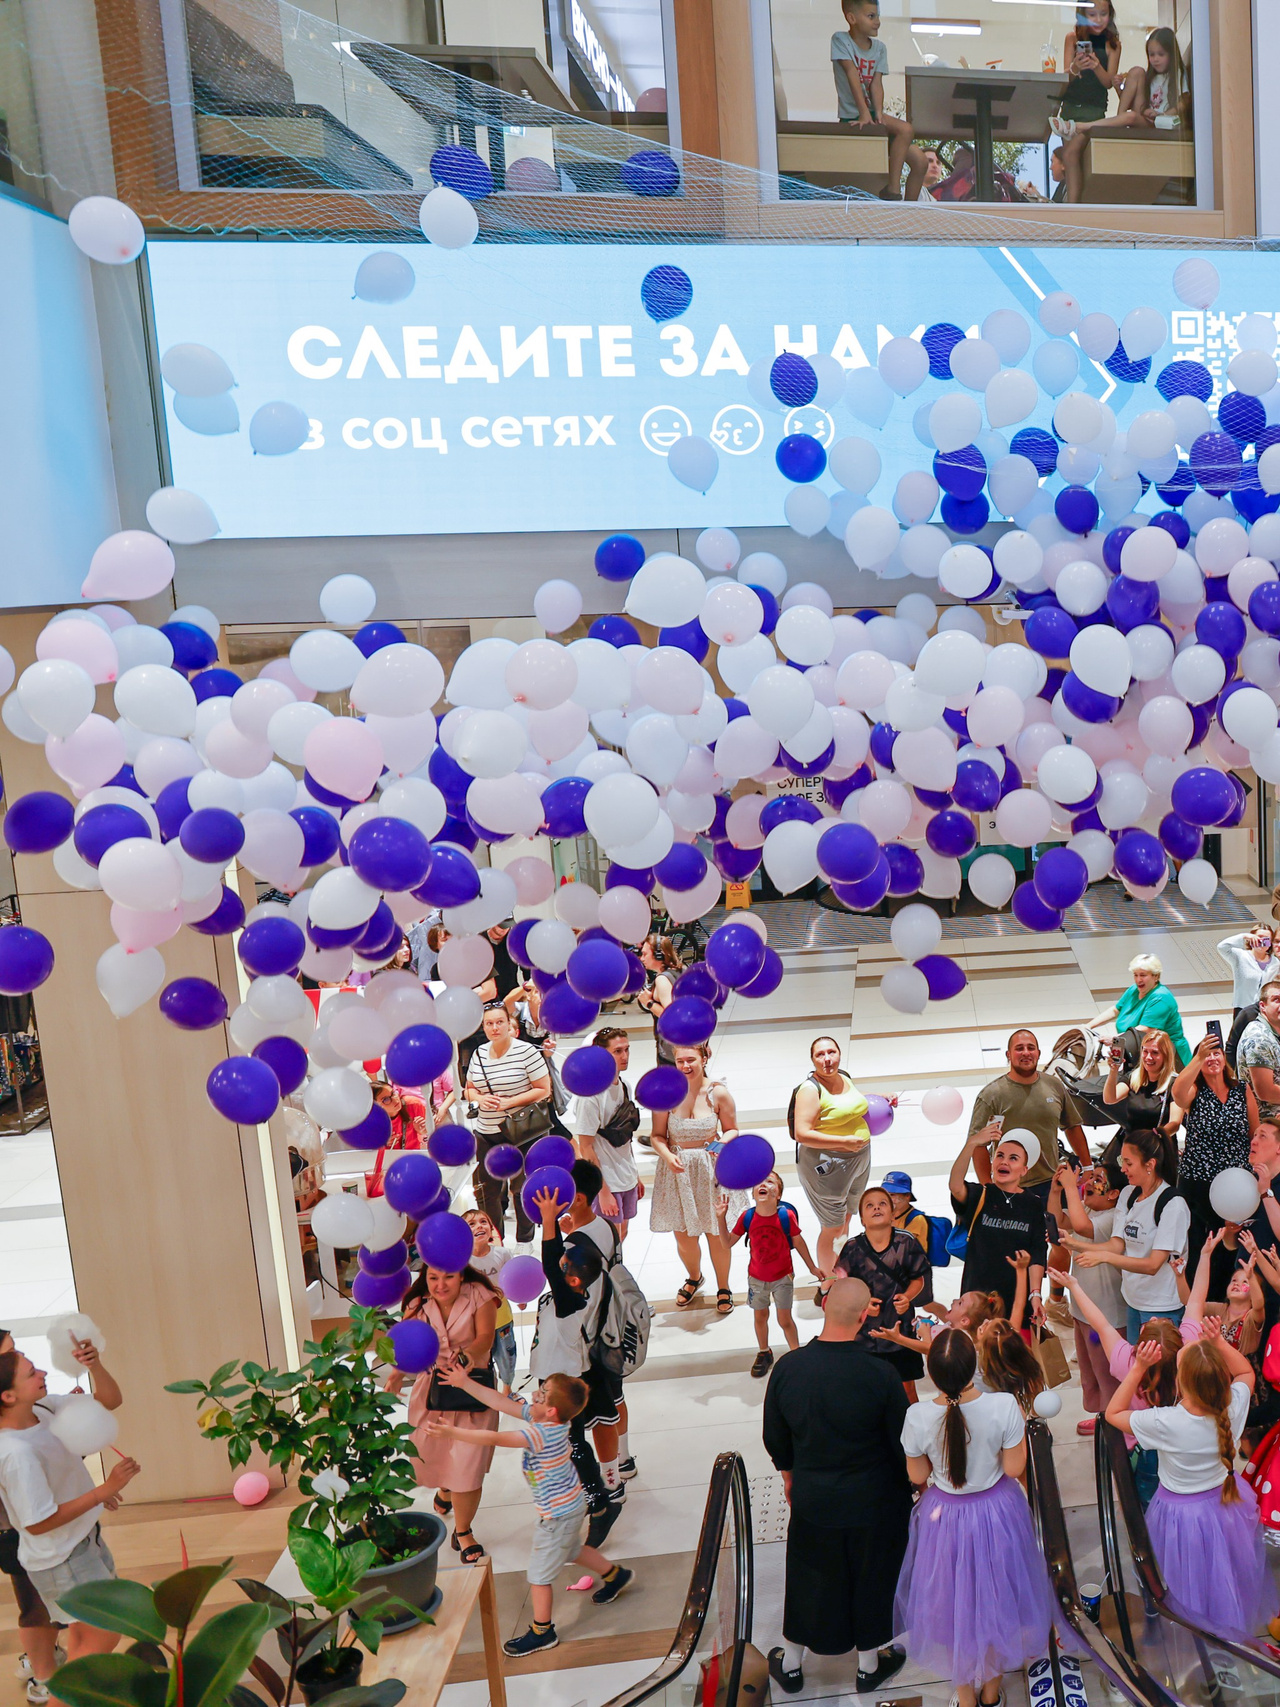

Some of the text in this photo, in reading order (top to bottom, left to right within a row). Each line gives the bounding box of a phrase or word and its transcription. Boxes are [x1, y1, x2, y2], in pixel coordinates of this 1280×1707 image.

[287, 323, 979, 383] СЛЕДИТЕ ЗА НА
[341, 416, 448, 455] соц
[463, 412, 616, 451] сетях
[623, 1320, 638, 1366] NIKE
